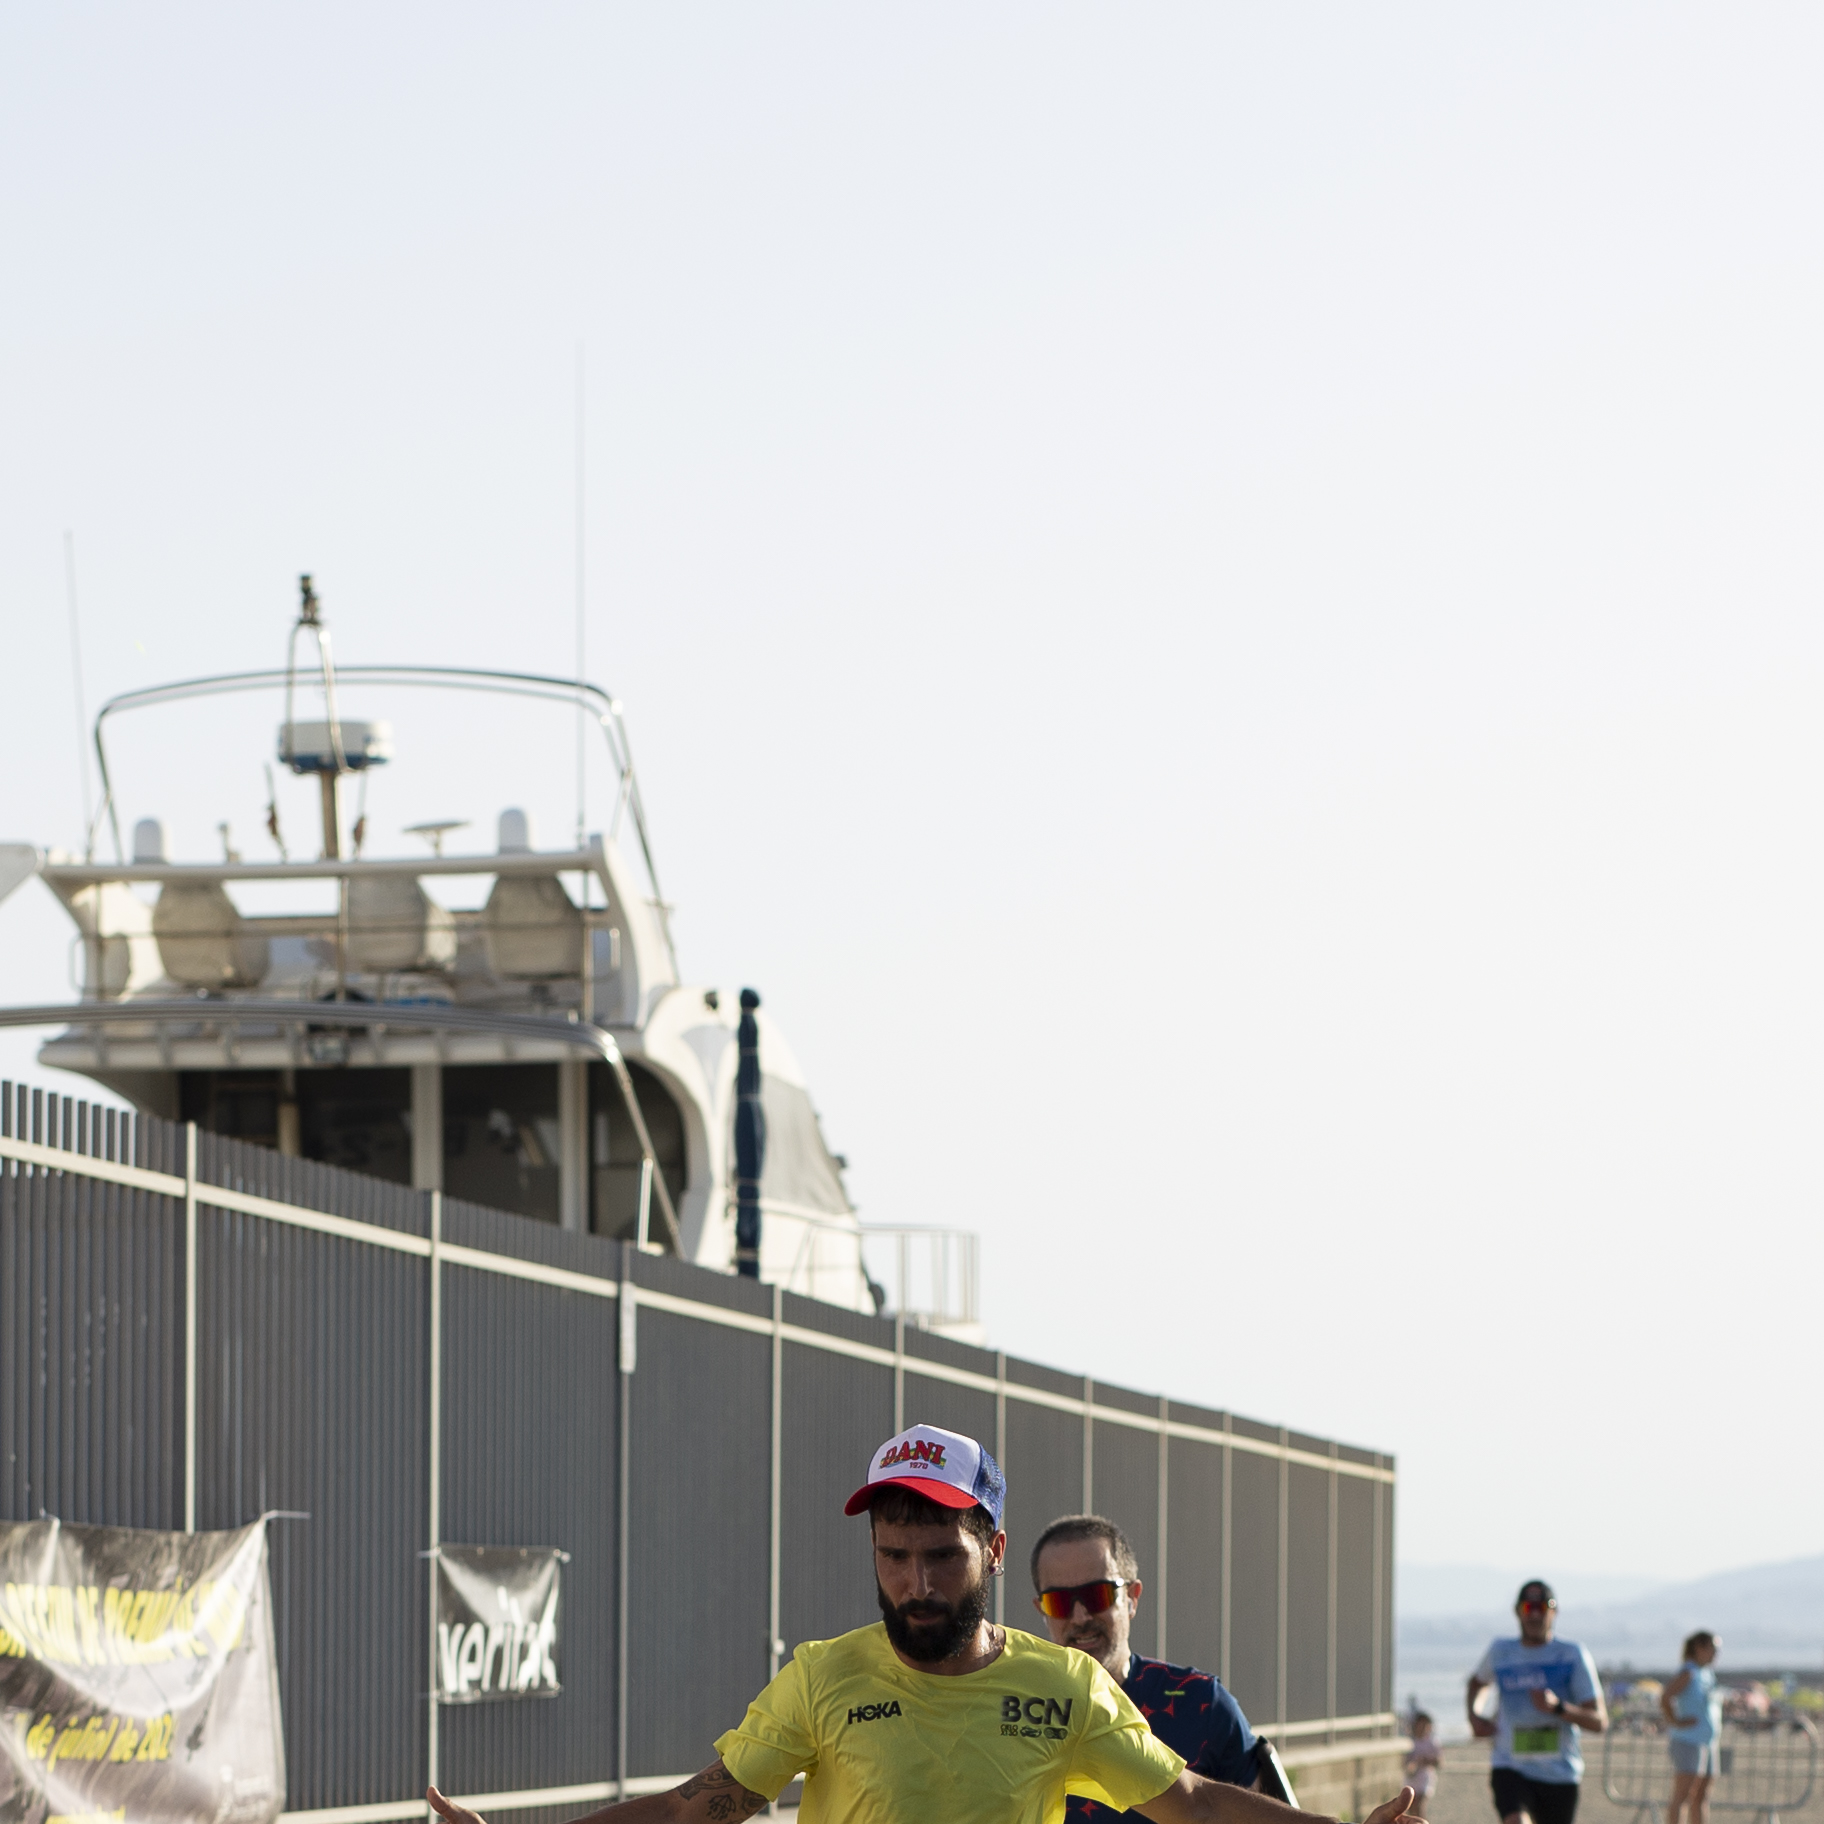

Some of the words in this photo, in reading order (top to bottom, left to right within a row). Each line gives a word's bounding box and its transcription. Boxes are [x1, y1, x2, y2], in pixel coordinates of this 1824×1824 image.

[880, 1440, 945, 1469] DANI
[847, 1700, 903, 1725] HOKA
[1001, 1695, 1073, 1727] BCN
